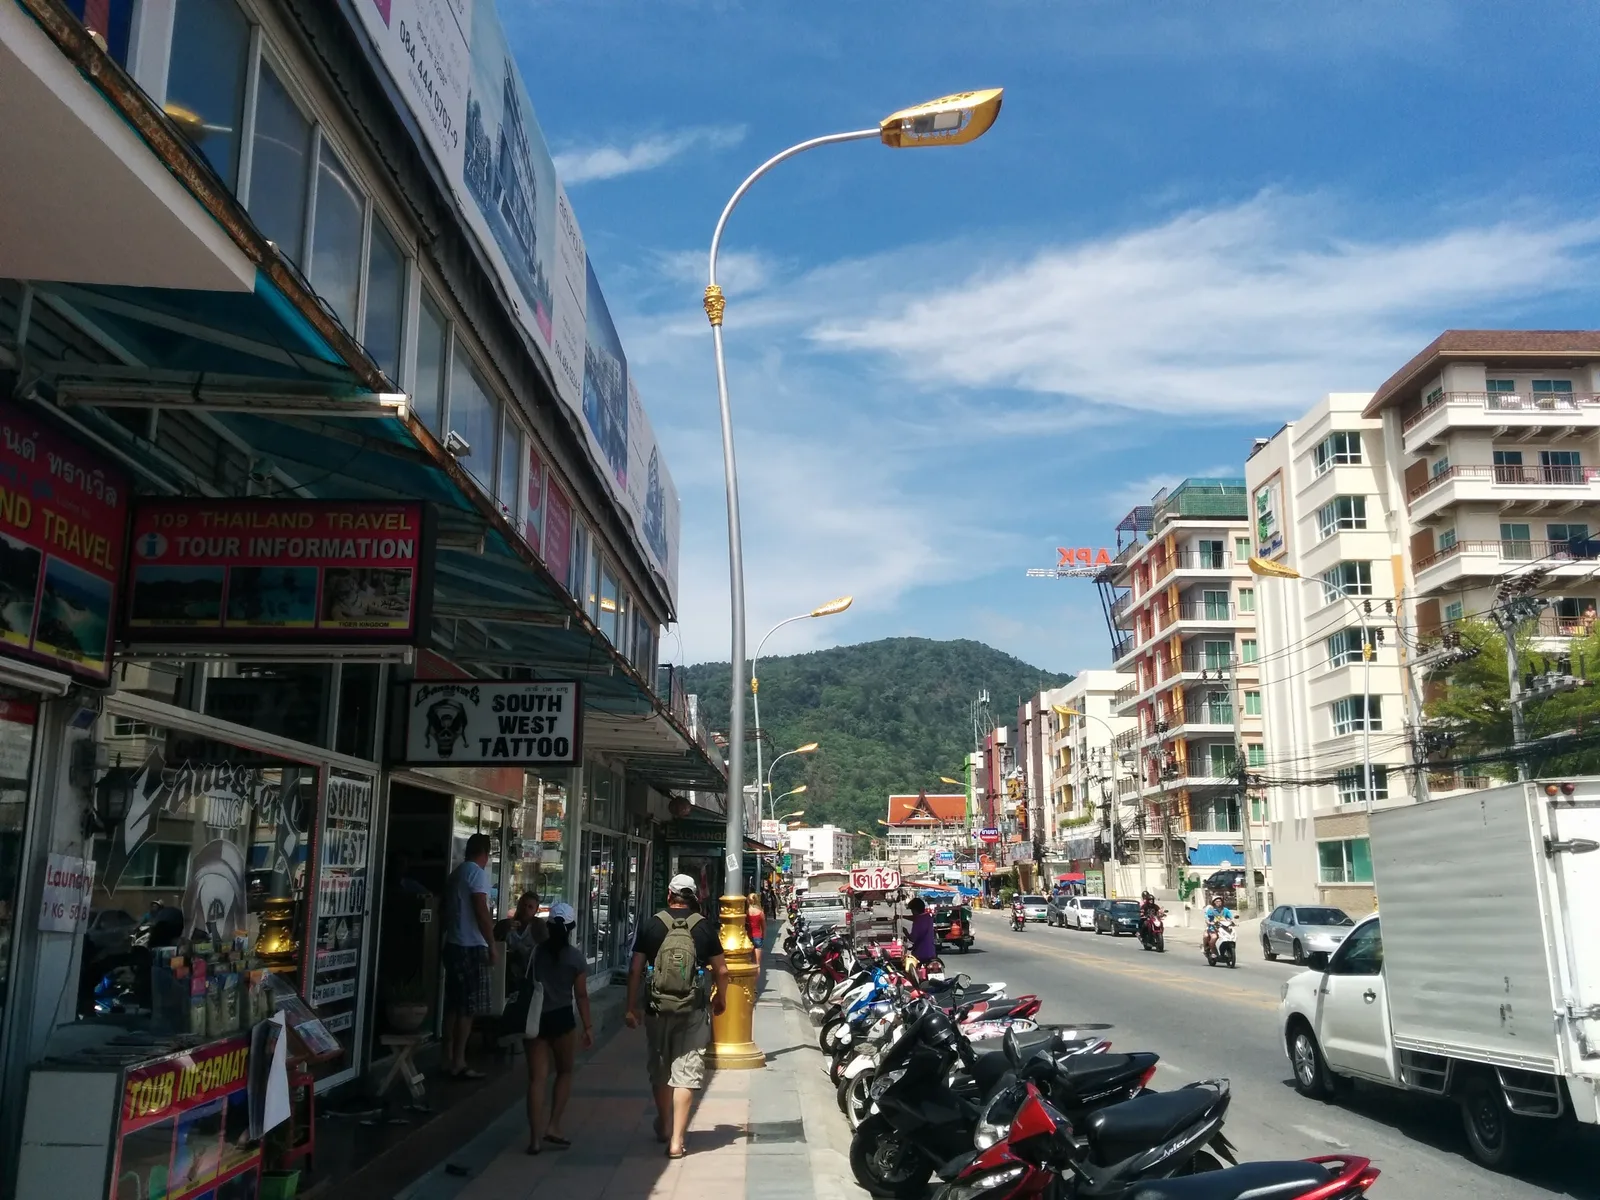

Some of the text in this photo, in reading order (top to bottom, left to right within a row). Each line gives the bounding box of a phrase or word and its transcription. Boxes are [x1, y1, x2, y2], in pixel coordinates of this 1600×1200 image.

[399, 19, 416, 63] 084
[417, 59, 433, 99] 444
[434, 89, 458, 149] 0707-9
[0, 424, 39, 463] นด์
[152, 511, 412, 531] 109 THAILAND TRAVEL
[41, 507, 115, 571] TRAVEL
[174, 536, 414, 560] TOUR INFORMATION
[491, 694, 562, 713] SOUTH
[498, 715, 558, 735] WEST
[479, 737, 569, 758] TATTOO
[329, 779, 370, 819] SOUTH
[323, 832, 366, 866] WEST
[47, 864, 93, 896] Laundry
[320, 877, 364, 915] TATTOO
[43, 901, 48, 917] 1
[51, 902, 64, 919] KG
[128, 1070, 176, 1120] TOUR
